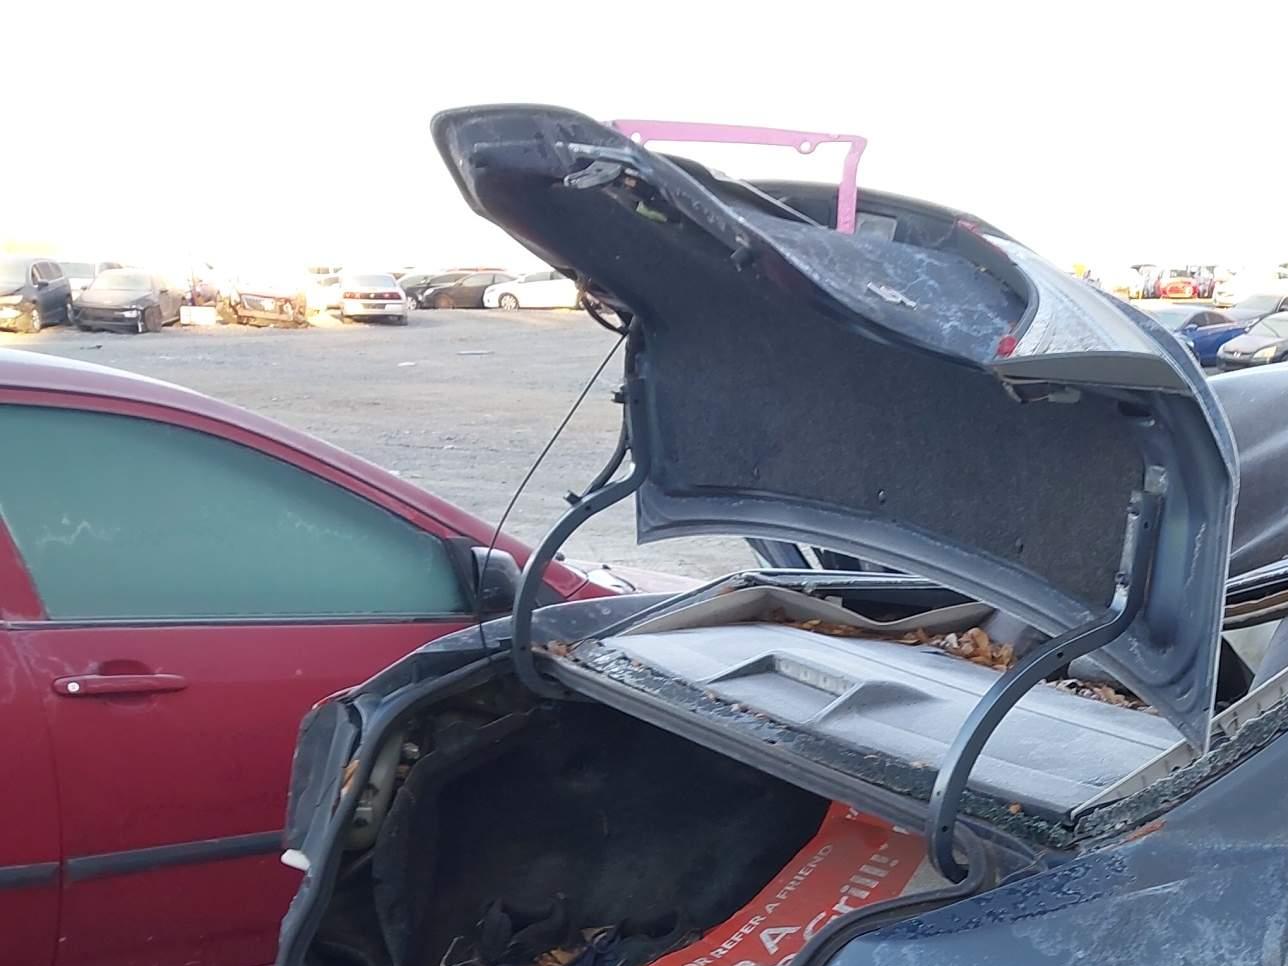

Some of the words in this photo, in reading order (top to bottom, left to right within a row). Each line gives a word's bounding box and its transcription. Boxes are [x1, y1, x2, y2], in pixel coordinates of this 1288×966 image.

[710, 915, 768, 959] REFER
[765, 902, 781, 914] A
[776, 844, 833, 900] FRIEND
[759, 925, 802, 955] A
